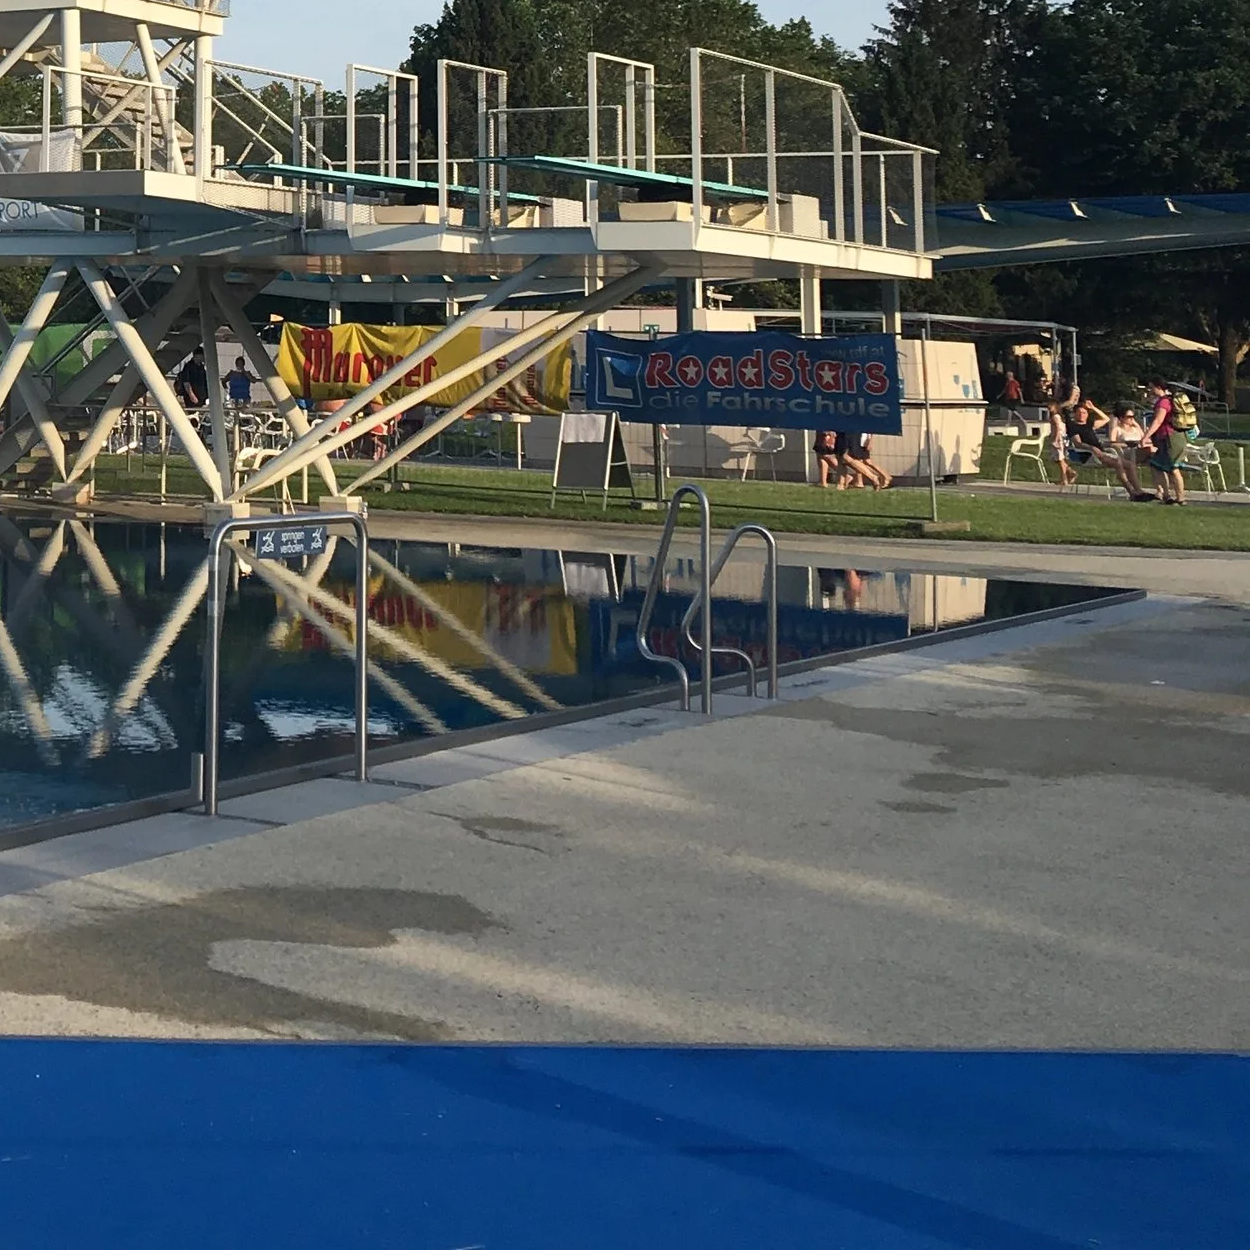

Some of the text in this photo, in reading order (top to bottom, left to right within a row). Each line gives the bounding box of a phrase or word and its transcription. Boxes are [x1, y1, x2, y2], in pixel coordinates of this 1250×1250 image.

[645, 349, 890, 396] RoadStars
[650, 391, 890, 419] die Fahrschule
[281, 531, 304, 543] springen
[280, 542, 304, 553] verboten
